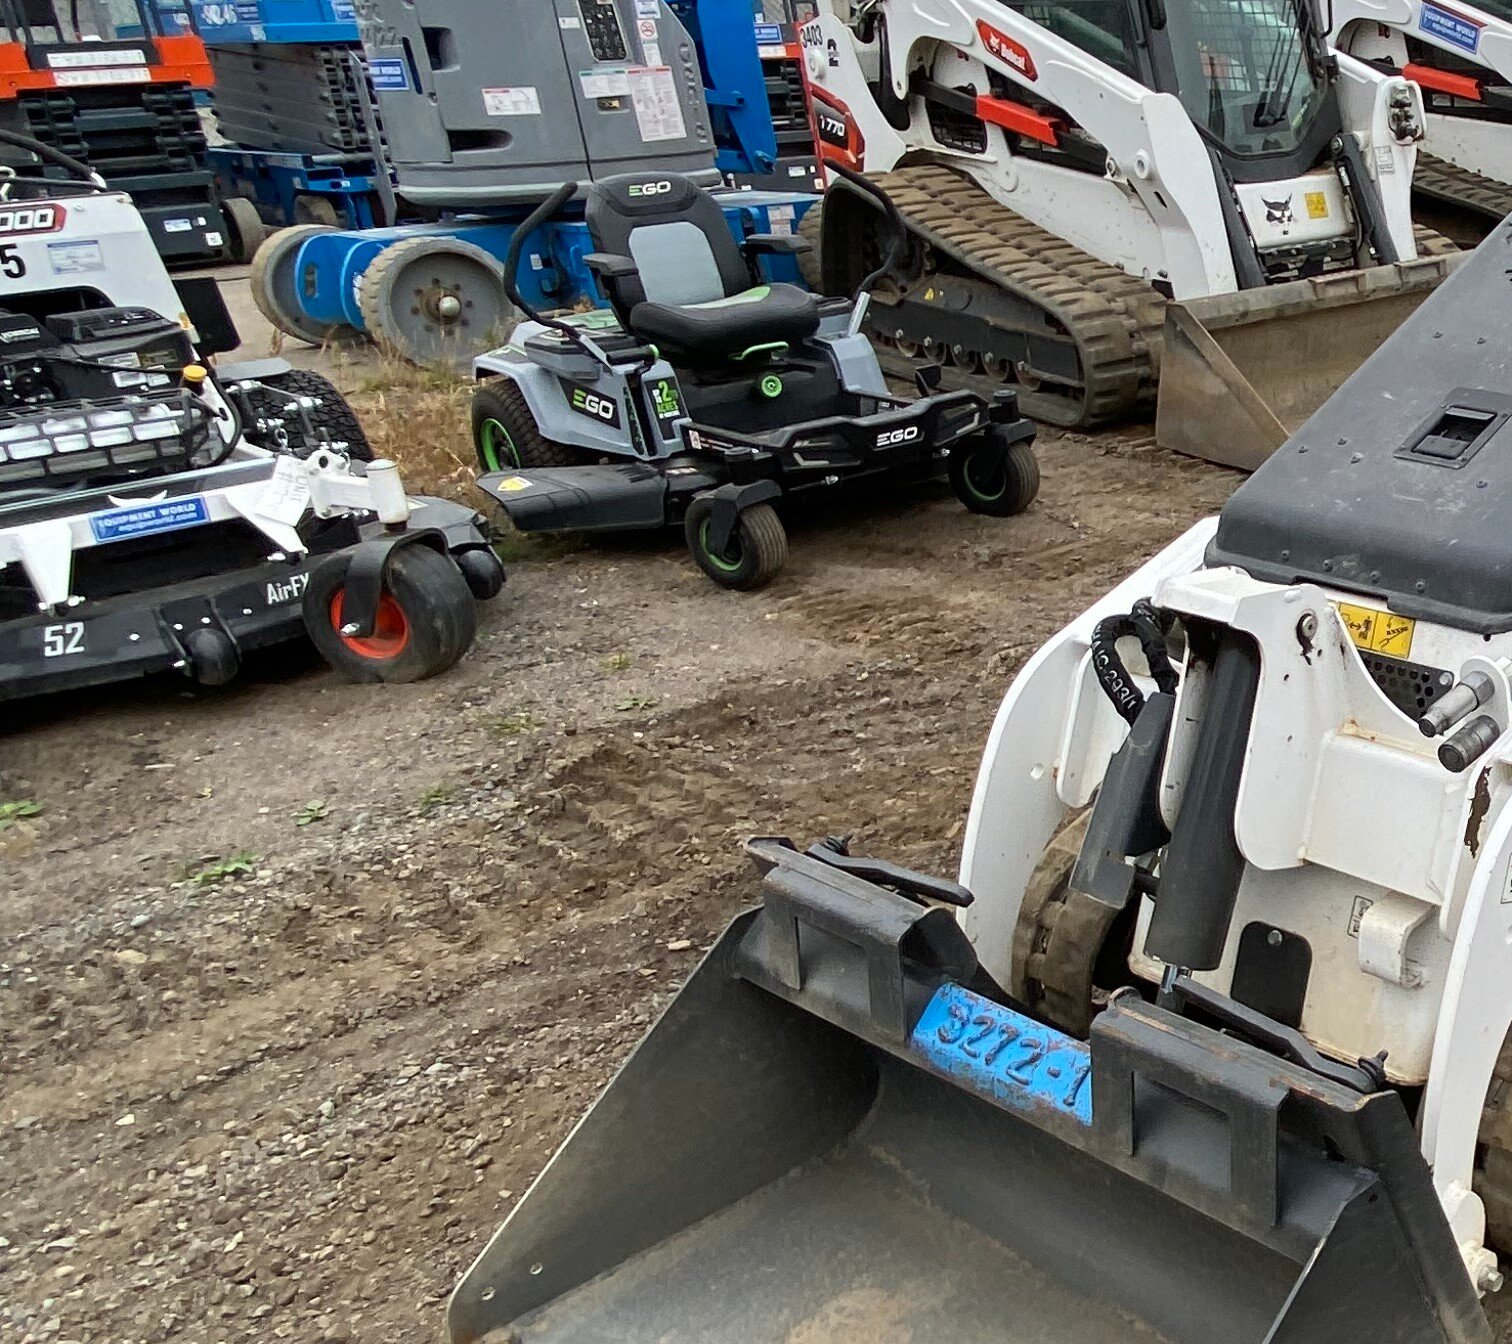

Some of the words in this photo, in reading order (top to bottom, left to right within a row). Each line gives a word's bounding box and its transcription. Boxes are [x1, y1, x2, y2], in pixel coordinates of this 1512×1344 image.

[1000, 42, 1026, 71] Bobcat
[629, 180, 672, 197] EGO
[0, 242, 27, 279] 5
[572, 388, 614, 420] EGO
[876, 426, 918, 447] EGO
[98, 508, 157, 529] EQUIPMENT
[158, 502, 198, 517] WORLD
[43, 621, 86, 657] 52
